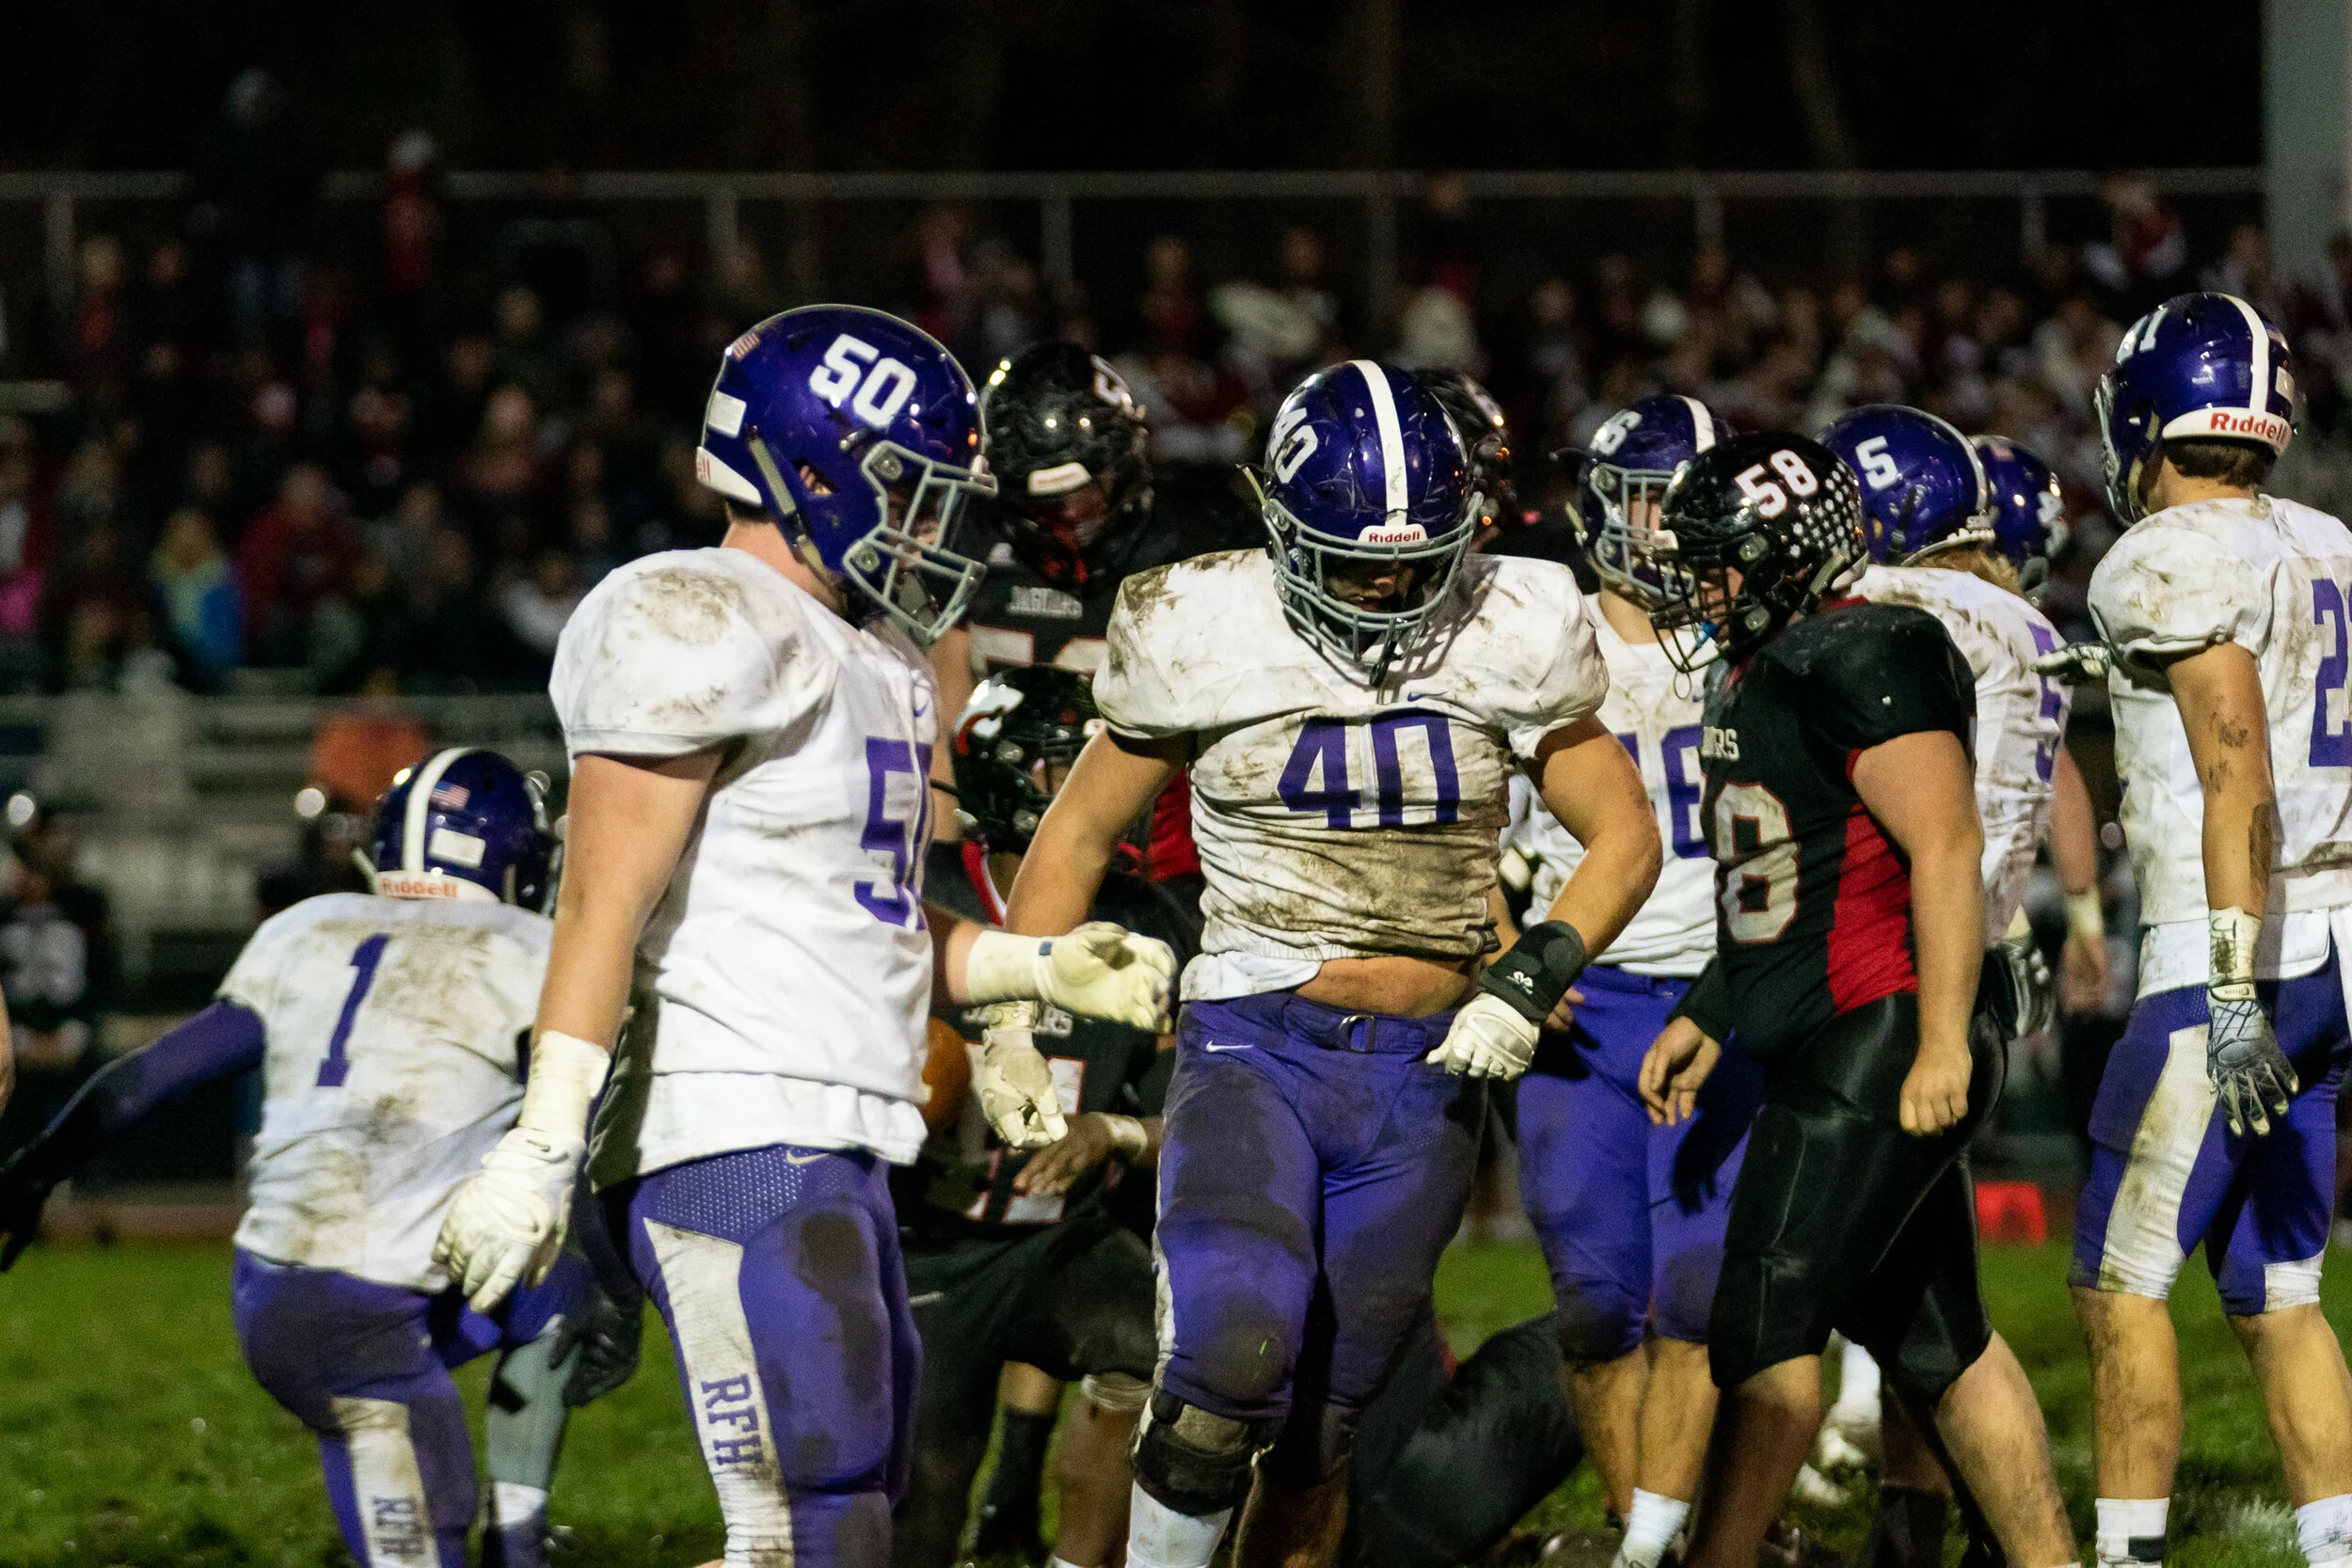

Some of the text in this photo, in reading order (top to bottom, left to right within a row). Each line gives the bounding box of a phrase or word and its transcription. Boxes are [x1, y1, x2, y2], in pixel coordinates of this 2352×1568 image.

[809, 333, 918, 428] 50
[1855, 436, 1899, 490] 5
[2210, 412, 2288, 445] Riddell
[1734, 450, 1820, 518] 58
[1368, 531, 1421, 544] Riddell
[2309, 578, 2352, 768] 2
[1278, 707, 1460, 829] 40
[853, 736, 933, 931] 5
[315, 932, 392, 1087] 1
[701, 1373, 764, 1466] RFH
